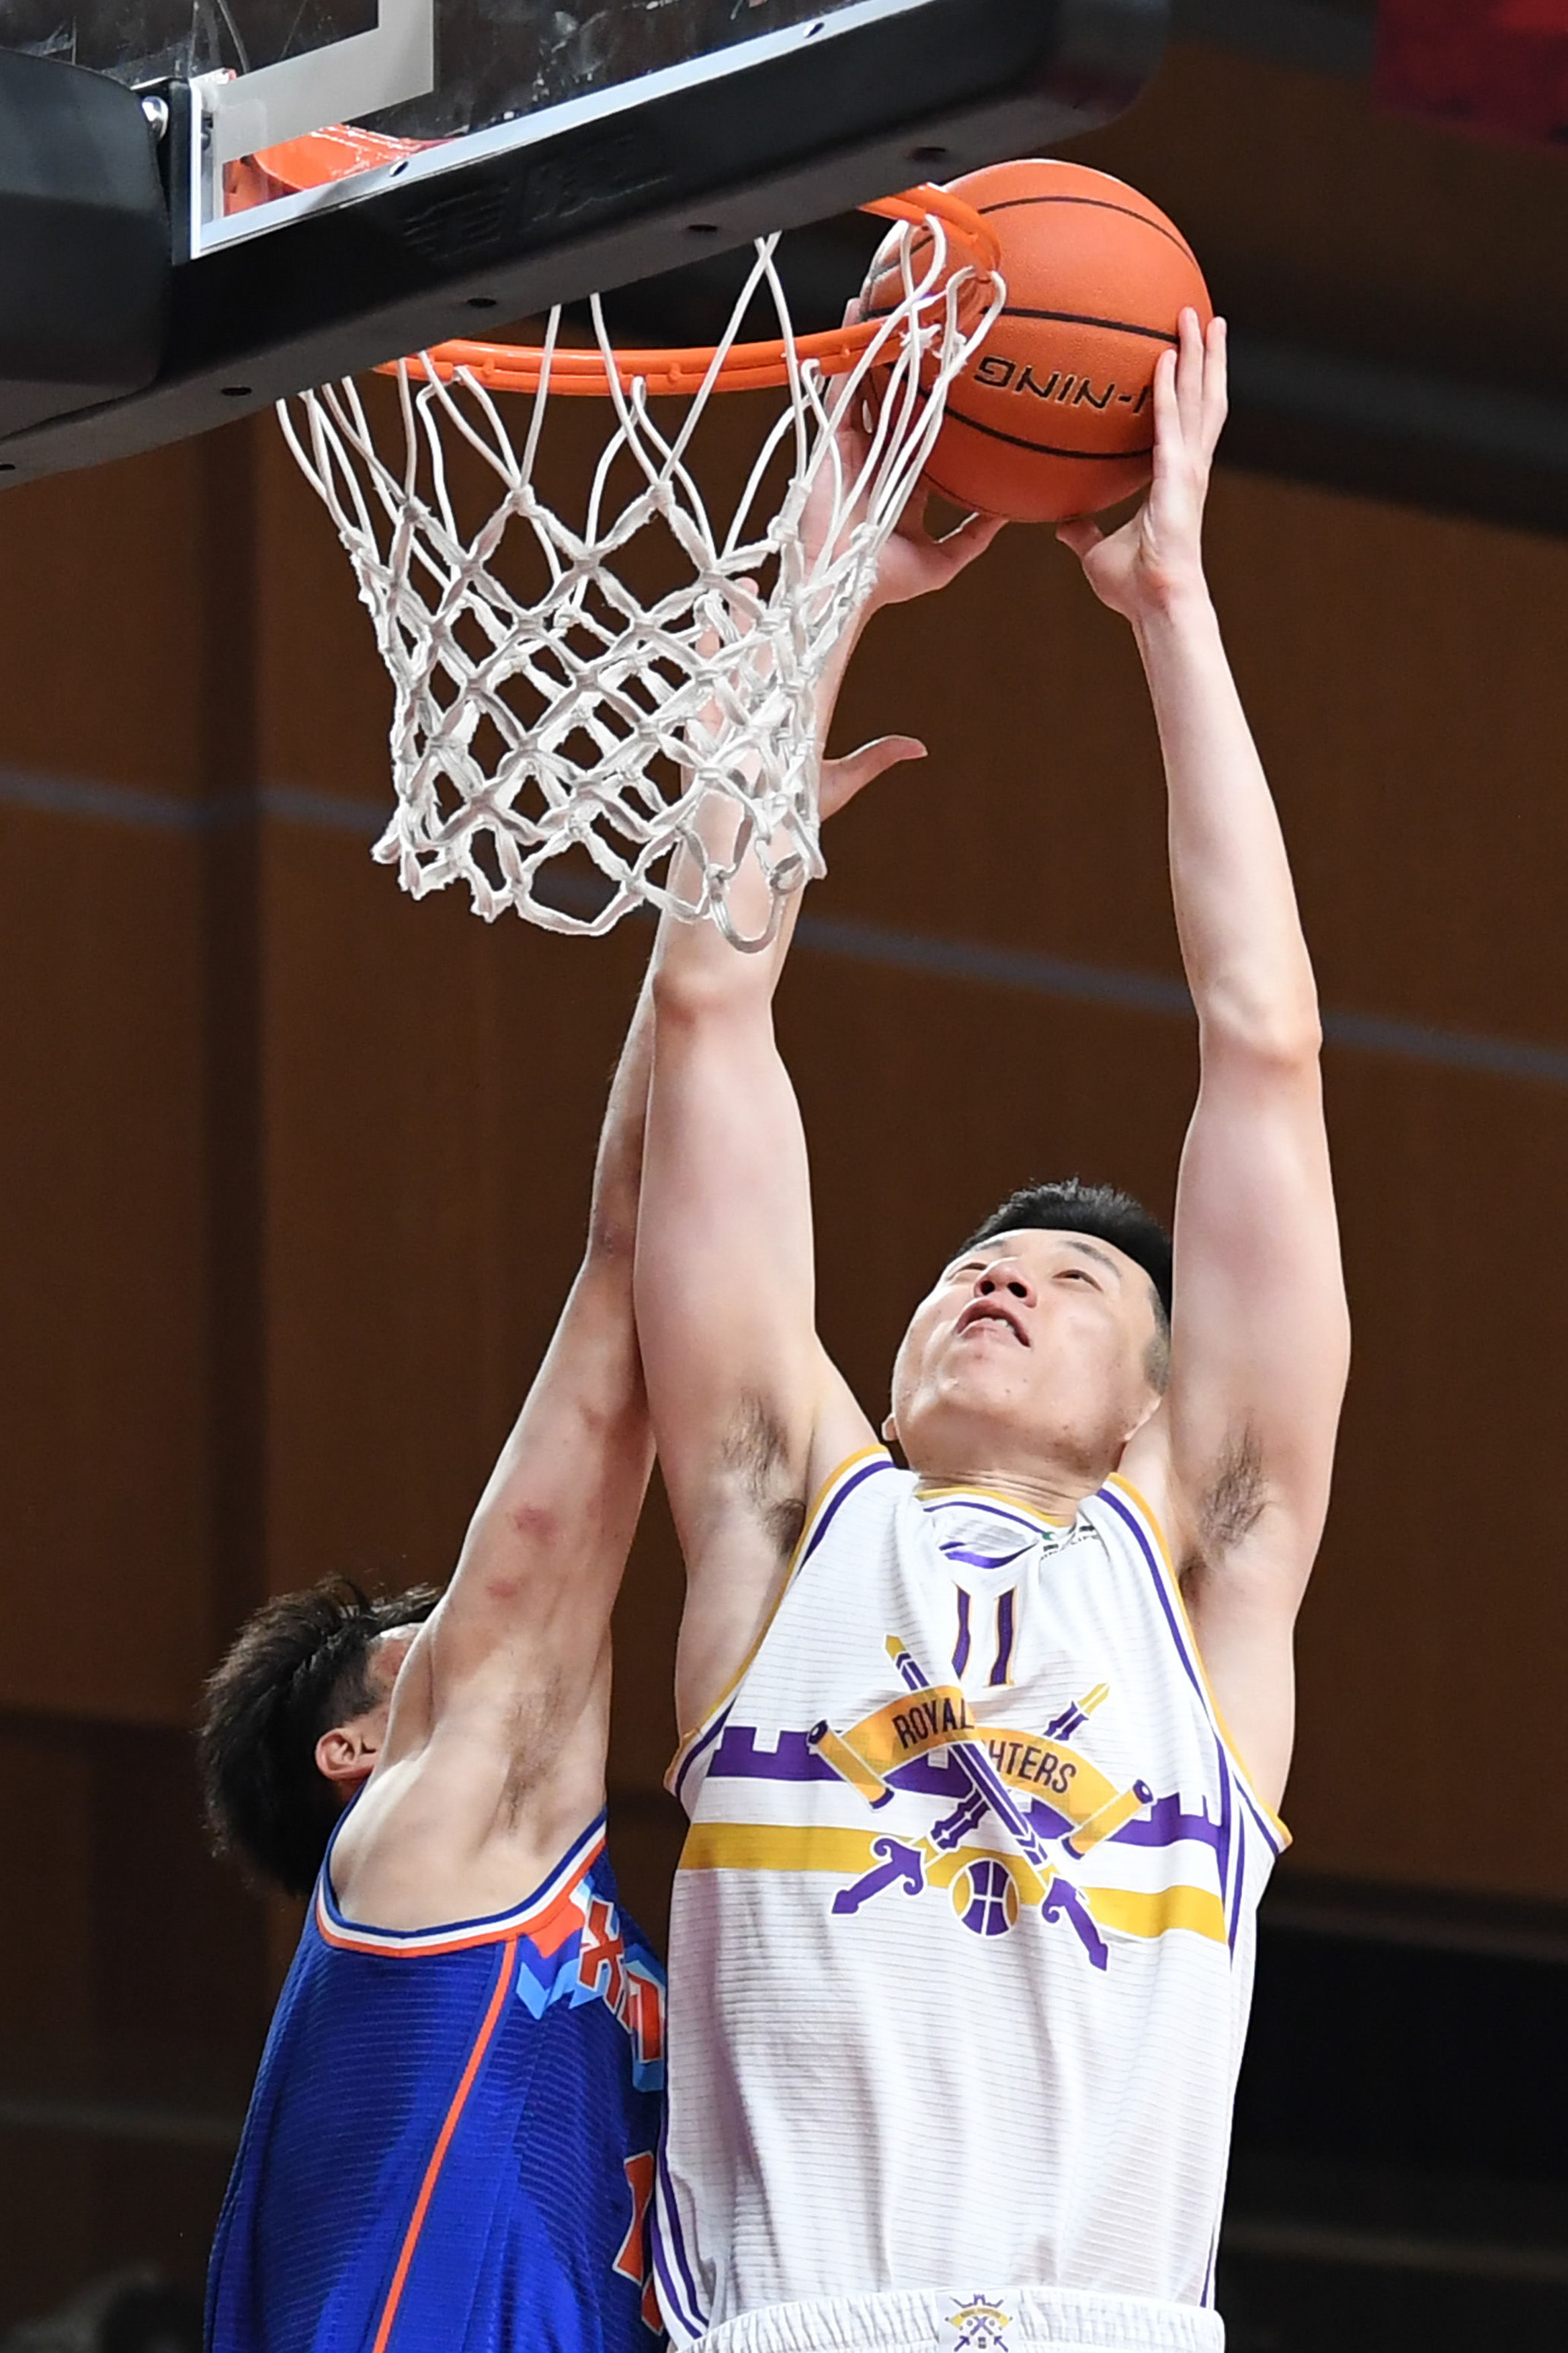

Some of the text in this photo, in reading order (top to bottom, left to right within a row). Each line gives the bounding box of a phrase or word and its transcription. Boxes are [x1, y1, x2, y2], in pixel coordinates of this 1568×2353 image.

[973, 355, 1153, 415] I-NING
[951, 1580, 1017, 1688] 11
[892, 1697, 1077, 1794] ROYAL HTERS
